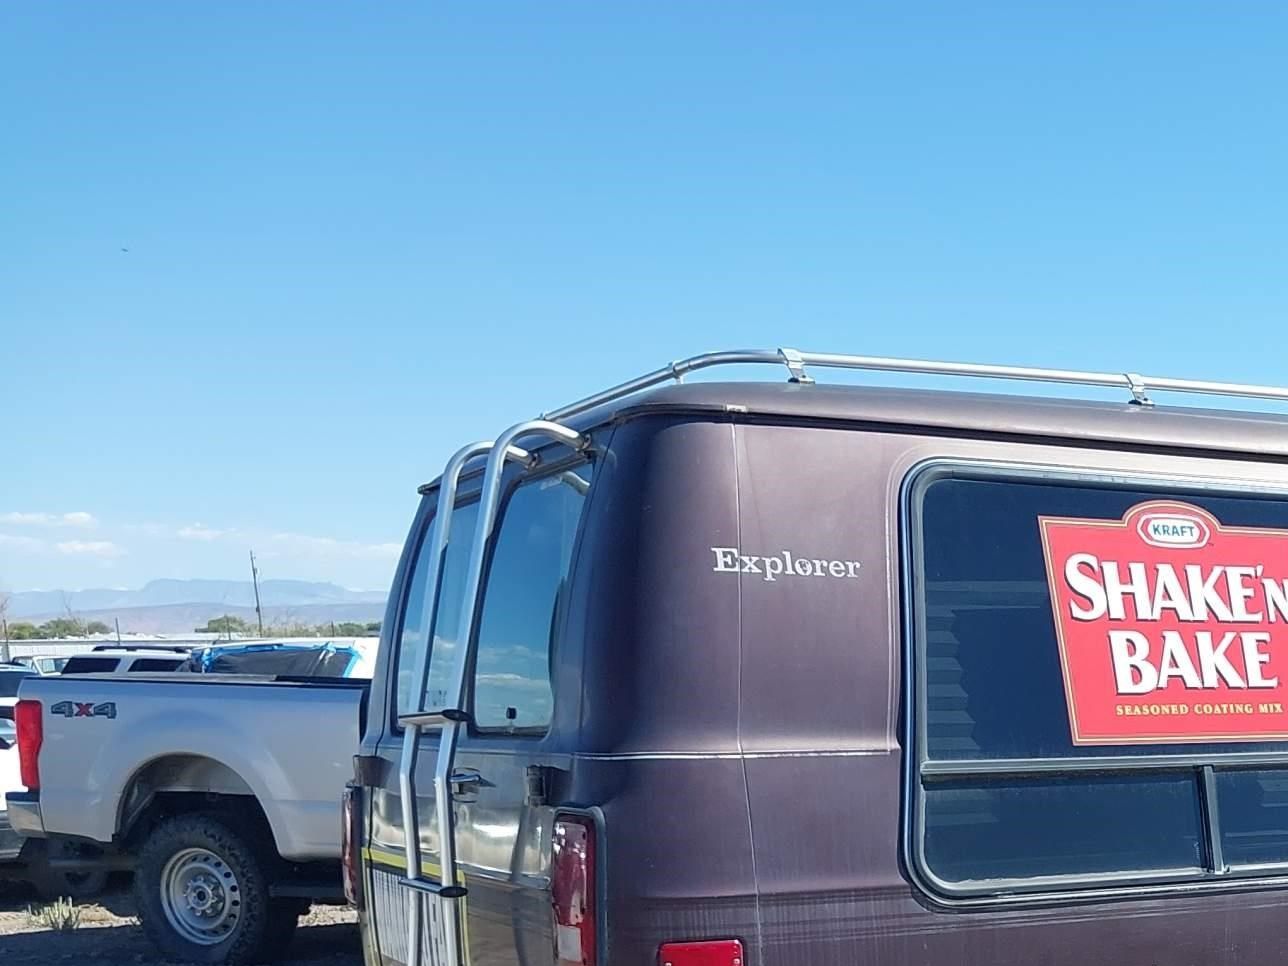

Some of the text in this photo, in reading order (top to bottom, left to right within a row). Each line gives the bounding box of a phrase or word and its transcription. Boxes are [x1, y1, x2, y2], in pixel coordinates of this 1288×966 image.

[1152, 523, 1195, 537] KRAFT
[711, 547, 861, 581] Explorer
[1108, 630, 1279, 695] BAKE
[1115, 702, 1284, 716] SEASONED COATING MIX
